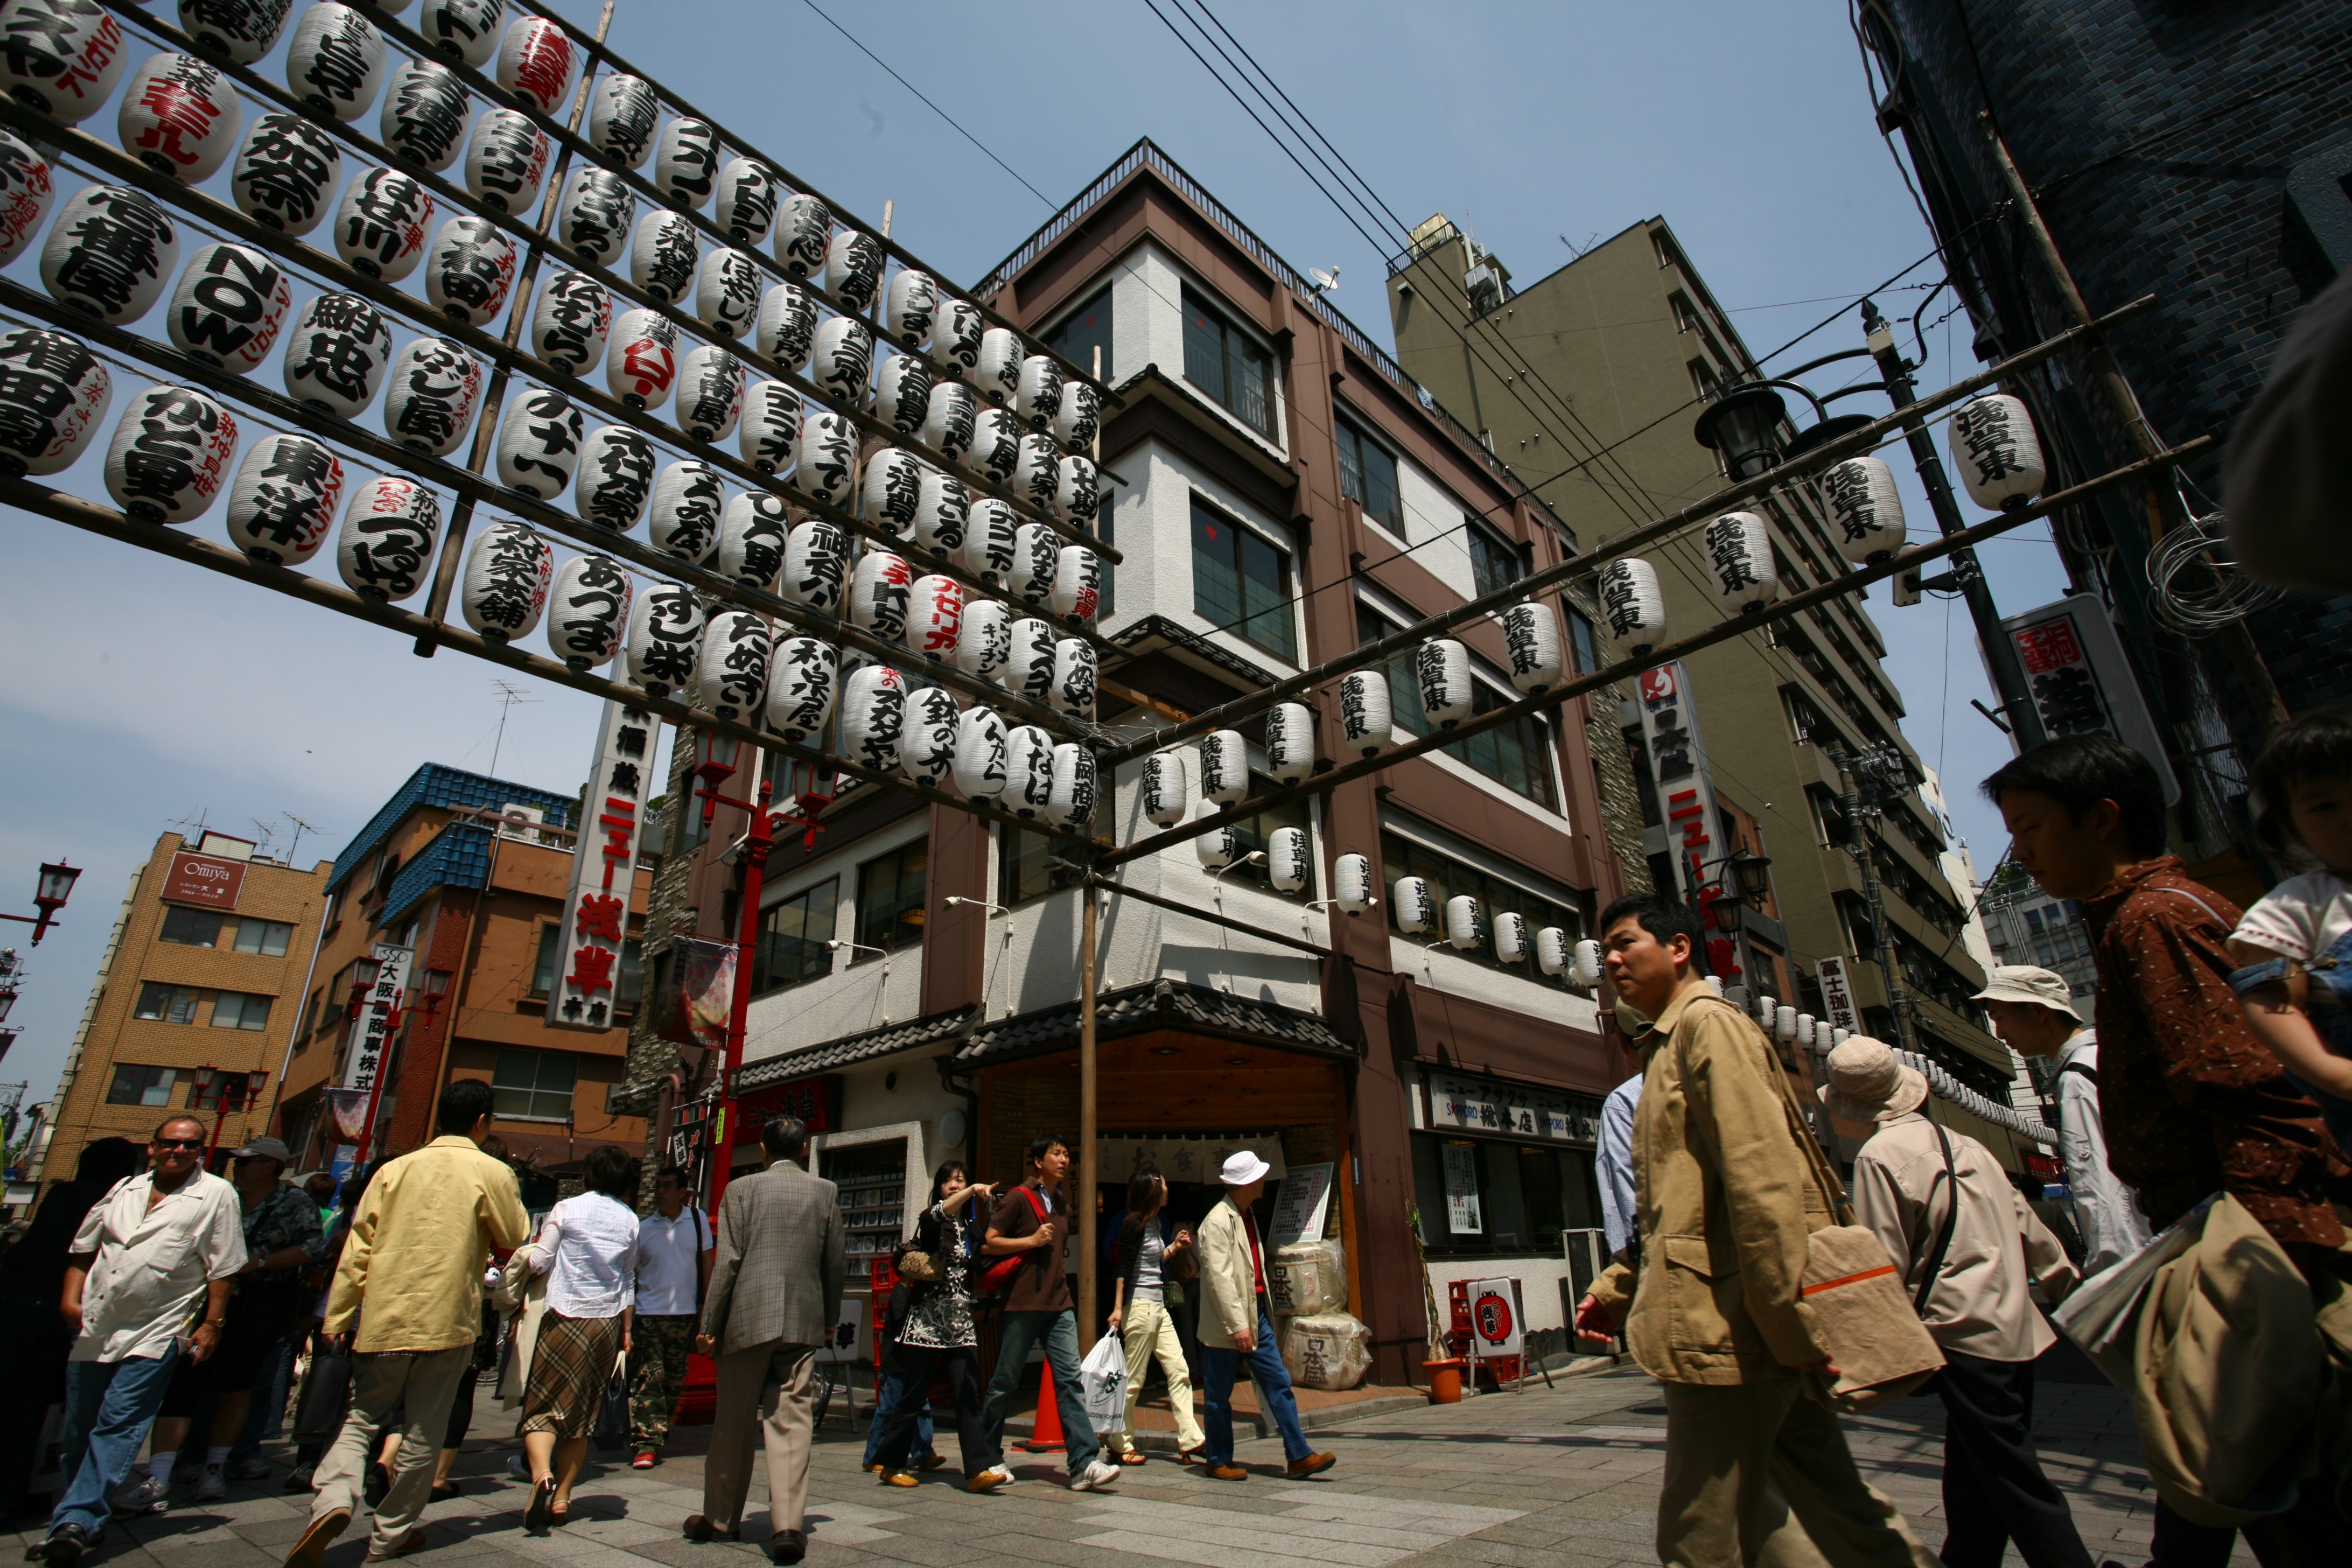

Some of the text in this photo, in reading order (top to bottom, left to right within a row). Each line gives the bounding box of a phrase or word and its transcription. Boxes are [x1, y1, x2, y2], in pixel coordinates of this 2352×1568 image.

[398, 194, 434, 257] 中華
[181, 246, 278, 358] NOW
[397, 338, 470, 446] ふじ屋
[1957, 399, 2025, 487] 浅草東
[246, 438, 331, 545] 東洋
[1825, 461, 1883, 543] 浅草東
[475, 523, 542, 630] 木村家本舗
[1705, 516, 1760, 596] 浅草東
[1599, 559, 1646, 640] 浅草東
[720, 615, 770, 705] たぬき
[1418, 643, 1451, 712] 浅草東
[1505, 606, 1542, 677] 浅草東
[185, 863, 230, 882] Omiya
[563, 996, 607, 1020] 本店
[1481, 1105, 1533, 1133] 総本店
[1566, 1117, 1599, 1140] 総本
